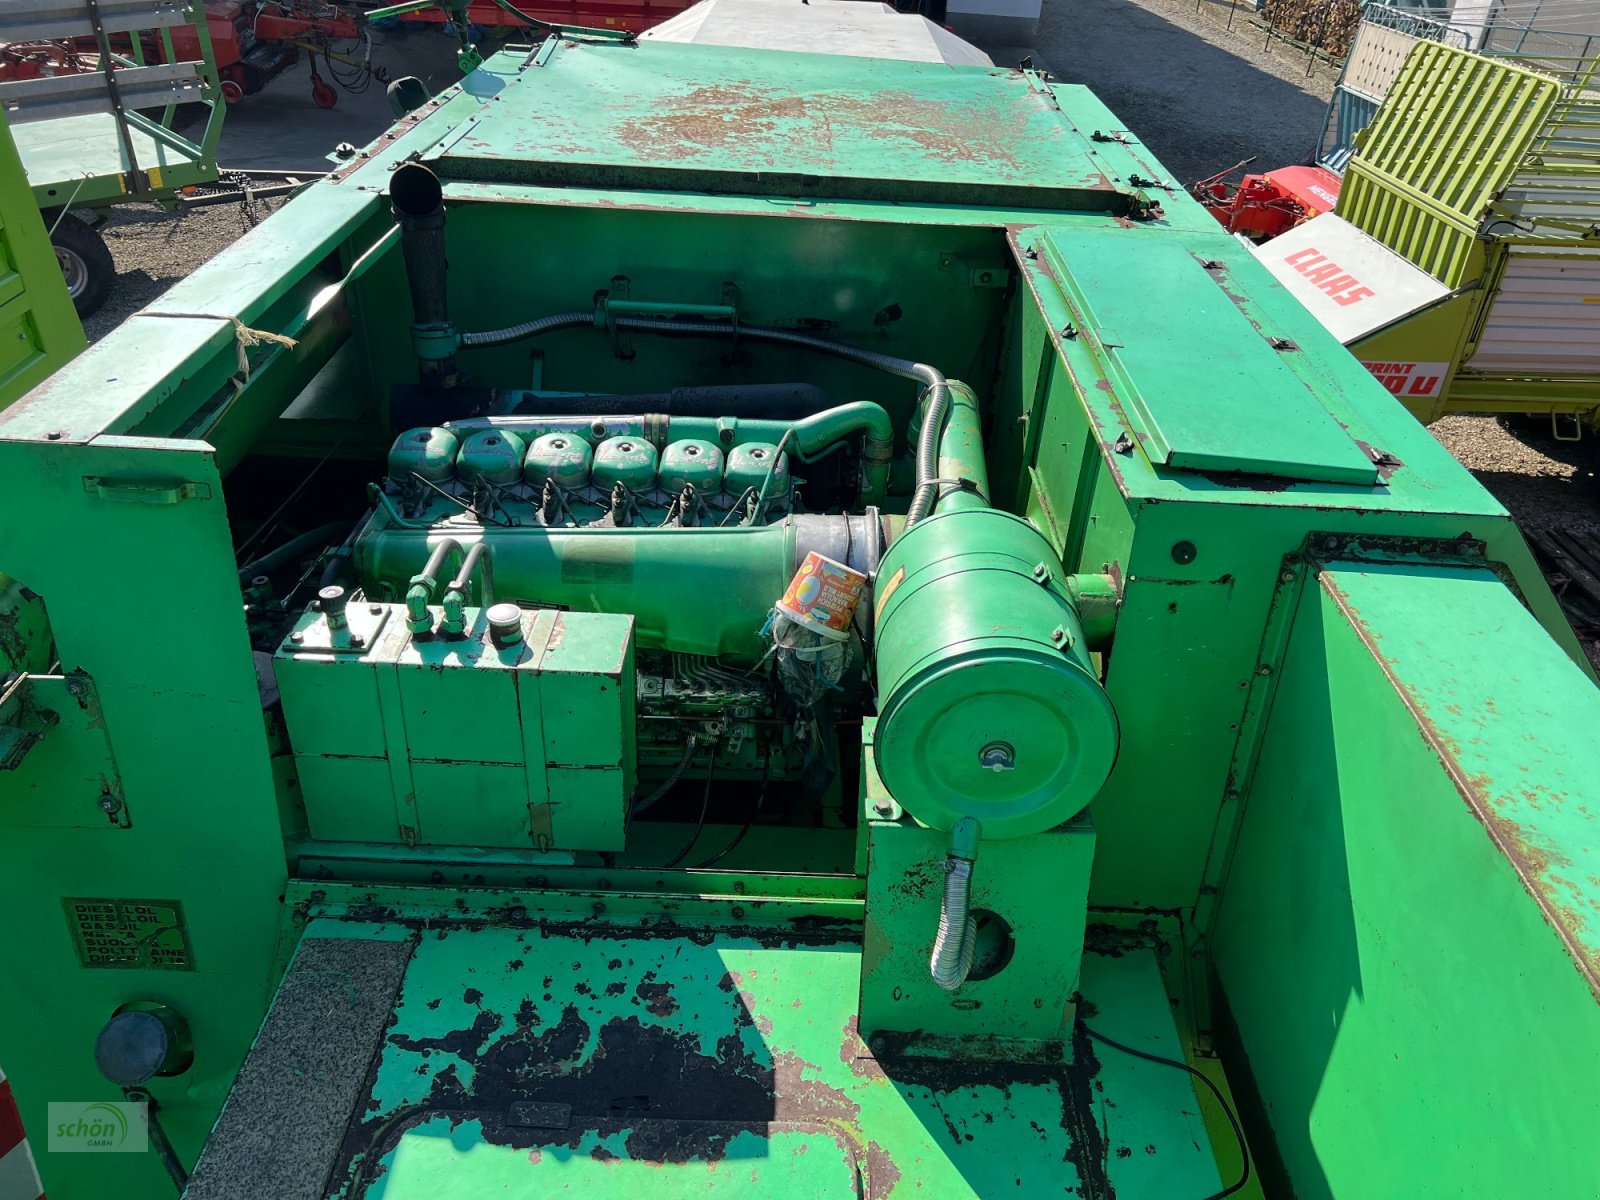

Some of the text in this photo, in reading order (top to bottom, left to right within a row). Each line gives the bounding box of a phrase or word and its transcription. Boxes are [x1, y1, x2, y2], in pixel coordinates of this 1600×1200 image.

[1284, 248, 1376, 306] CLAAS
[1408, 376, 1440, 395] U
[75, 904, 157, 915] DIESLOL
[78, 913, 164, 924] DIESLOIL
[87, 947, 185, 957] POLTTAINE
